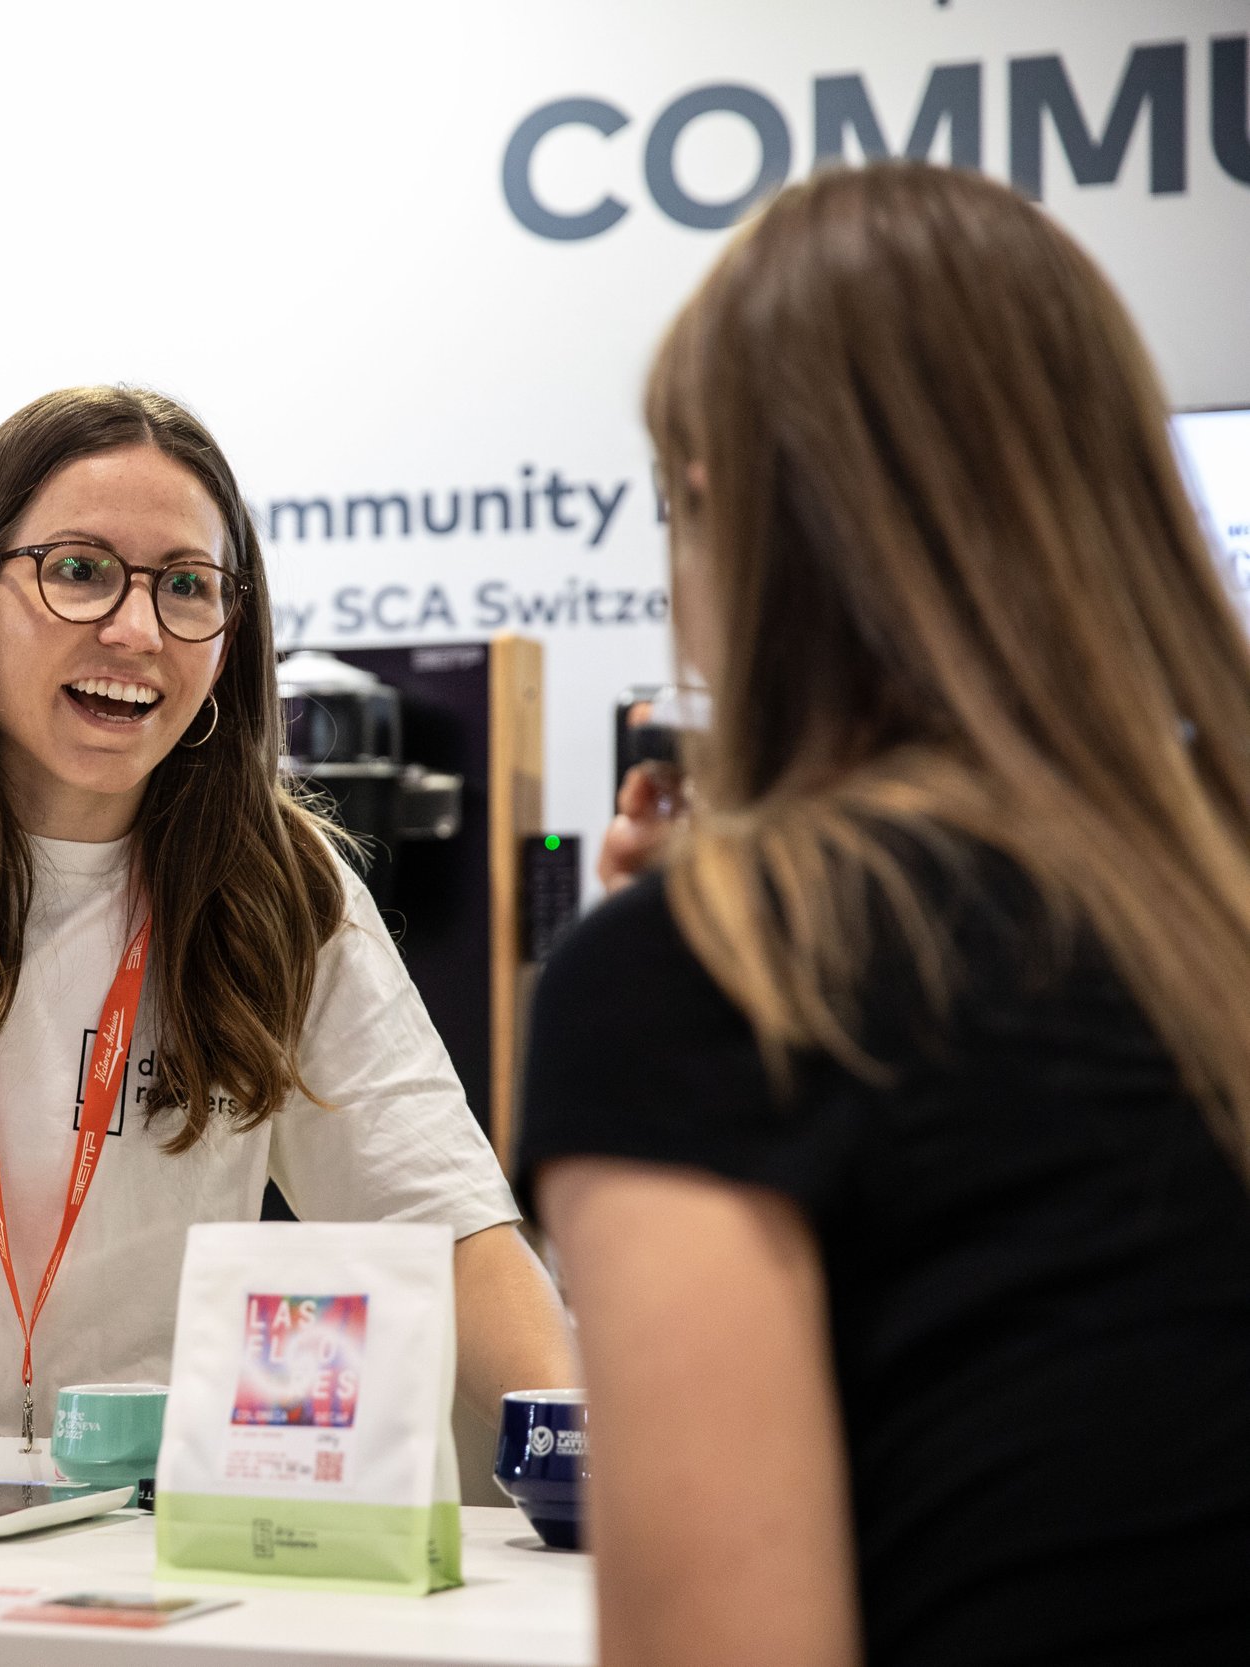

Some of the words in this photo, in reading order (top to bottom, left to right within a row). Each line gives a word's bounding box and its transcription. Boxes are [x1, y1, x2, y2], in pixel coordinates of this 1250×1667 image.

[269, 463, 628, 548] mmunity
[332, 585, 456, 635] SCA
[475, 577, 669, 630] Switze
[102, 1010, 120, 1047] Arduino
[94, 1048, 112, 1084] Victoria
[136, 1086, 240, 1115] rers
[249, 1298, 319, 1329] LAS
